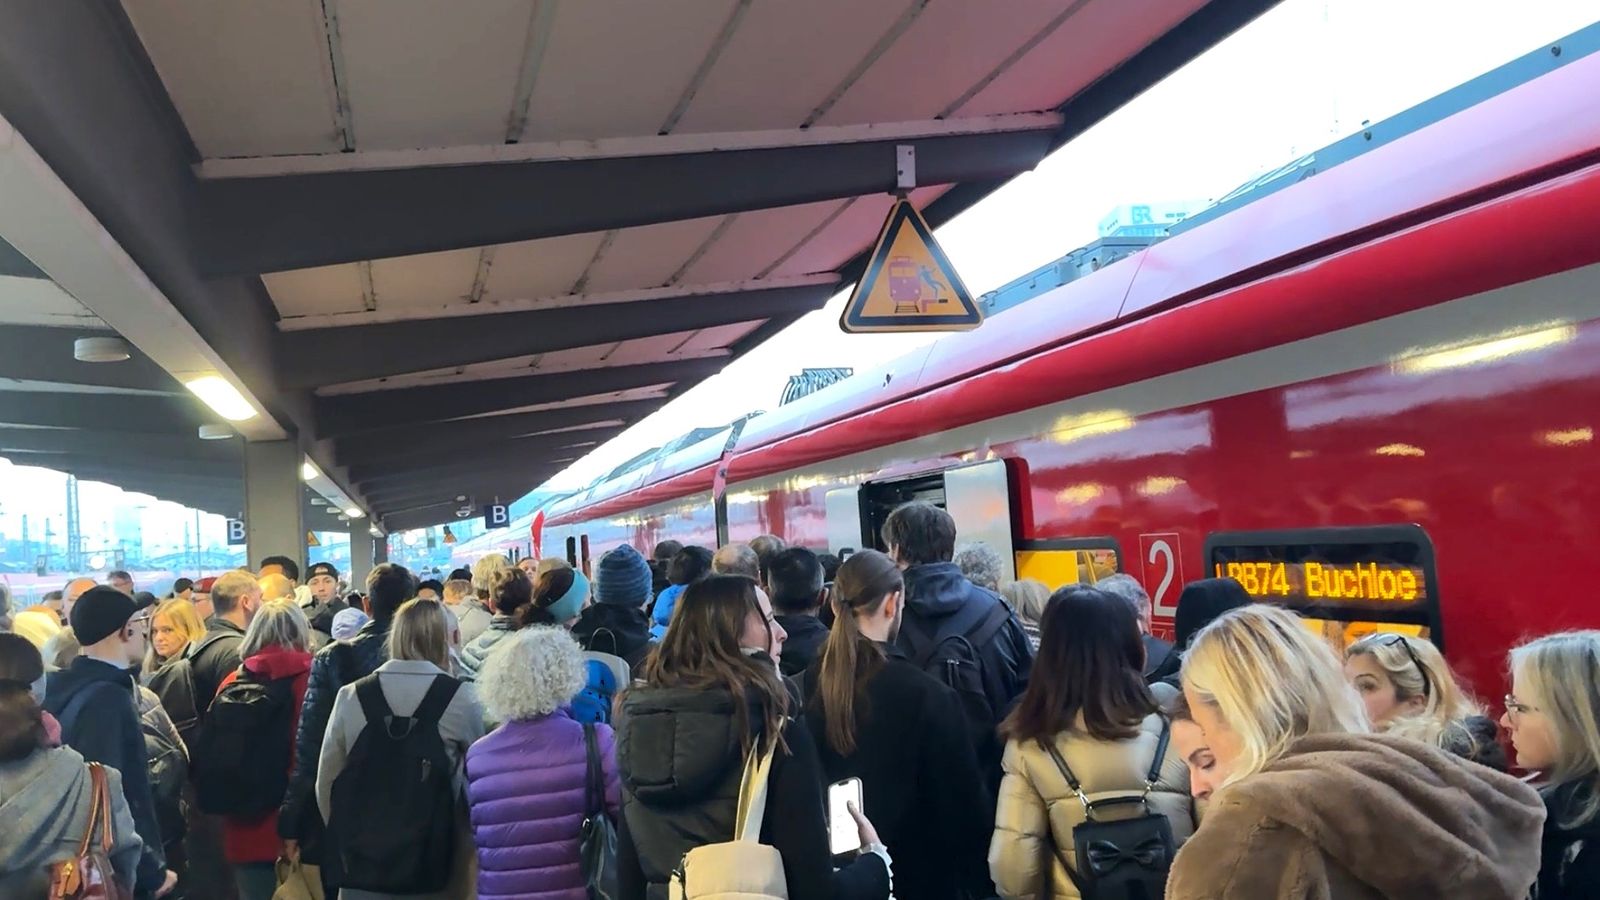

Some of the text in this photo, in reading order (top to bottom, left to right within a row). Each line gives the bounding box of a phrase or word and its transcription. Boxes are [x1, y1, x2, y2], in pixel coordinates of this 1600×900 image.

[492, 505, 507, 524] B
[229, 520, 246, 541] B
[1148, 540, 1178, 617] 2
[1304, 562, 1418, 600] Buchloe
